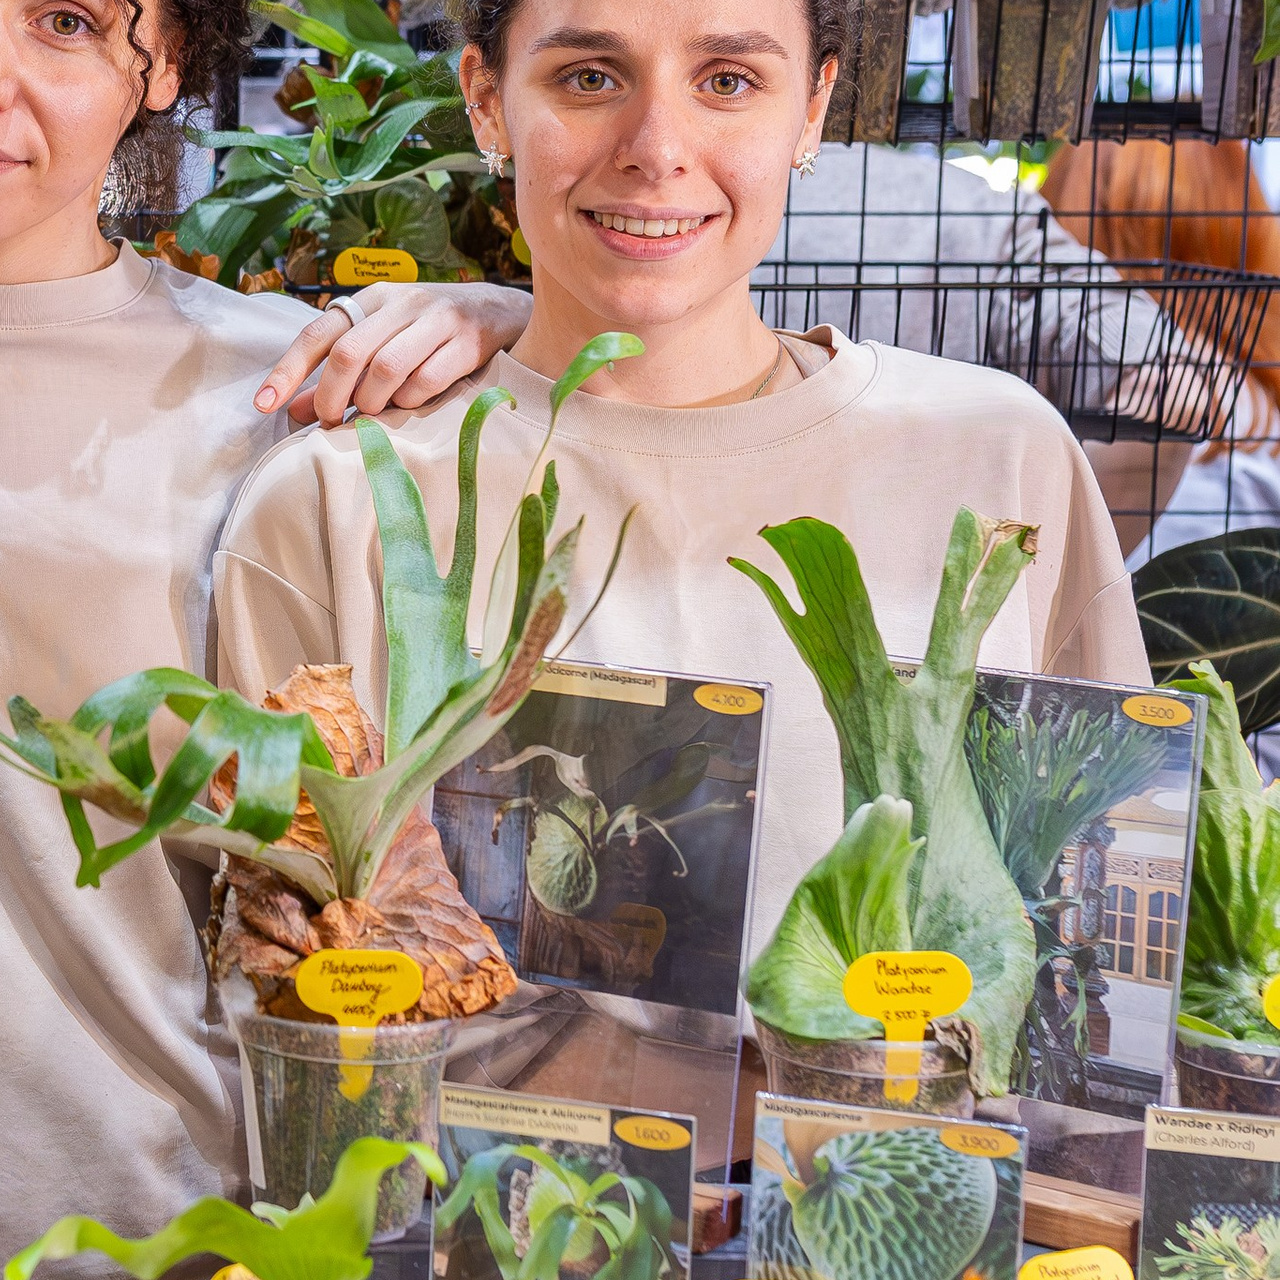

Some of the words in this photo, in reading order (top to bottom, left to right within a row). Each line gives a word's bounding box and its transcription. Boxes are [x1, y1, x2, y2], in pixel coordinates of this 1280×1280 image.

[589, 671, 656, 688] (Madagascar)
[1139, 704, 1175, 720] 3.500
[1154, 1114, 1213, 1131] Wandae
[1216, 1122, 1225, 1132] x
[1228, 1121, 1276, 1139] Ridleyi
[1154, 1131, 1208, 1147] (Charles
[1210, 1135, 1256, 1153] Alford)
